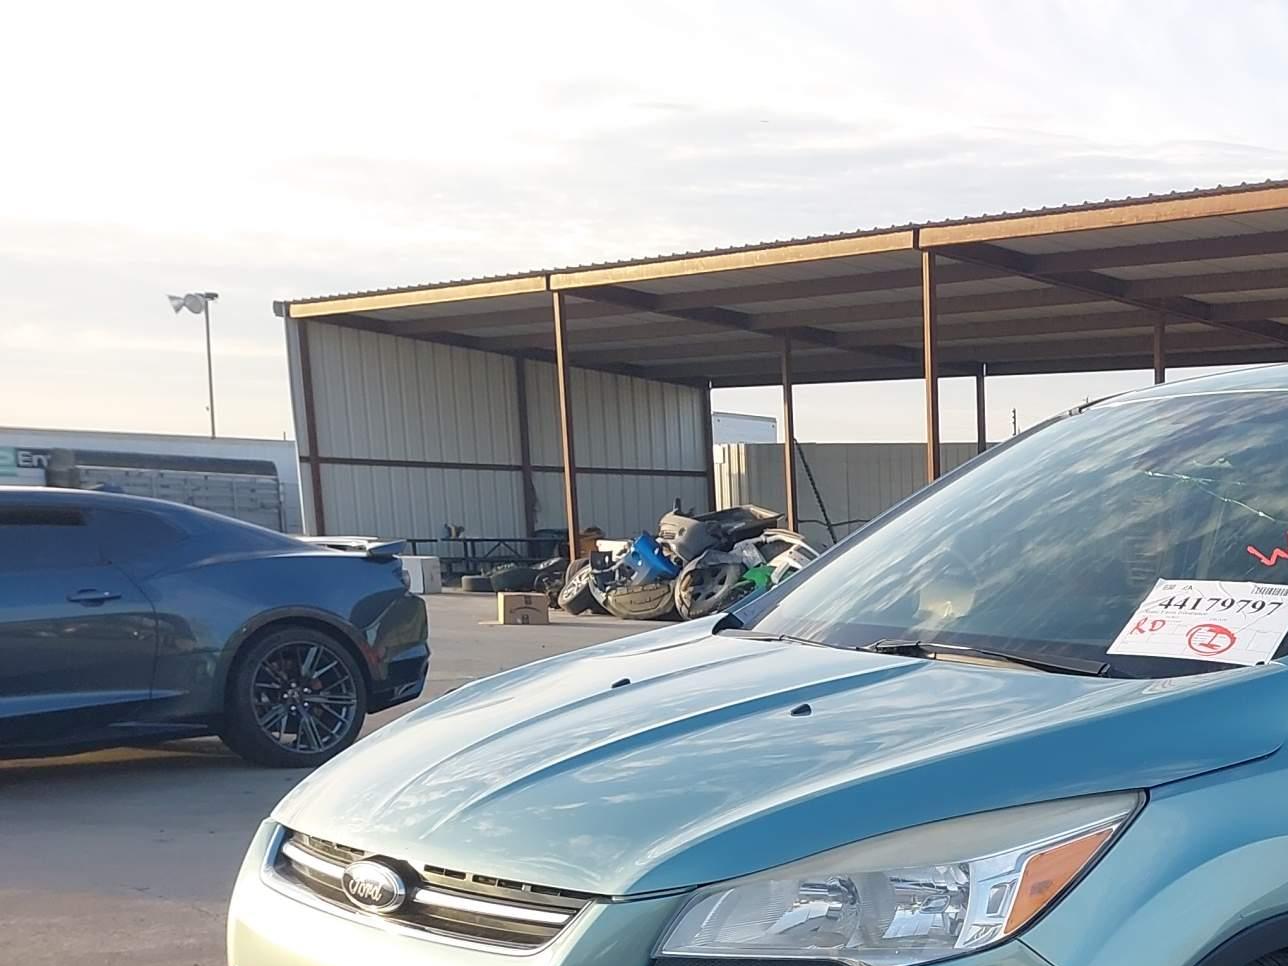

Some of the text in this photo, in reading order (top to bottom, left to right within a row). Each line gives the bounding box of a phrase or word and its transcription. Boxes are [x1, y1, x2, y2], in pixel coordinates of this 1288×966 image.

[1158, 596, 1284, 615] 44179797
[1129, 617, 1166, 635] RD
[348, 878, 382, 901] Ford
